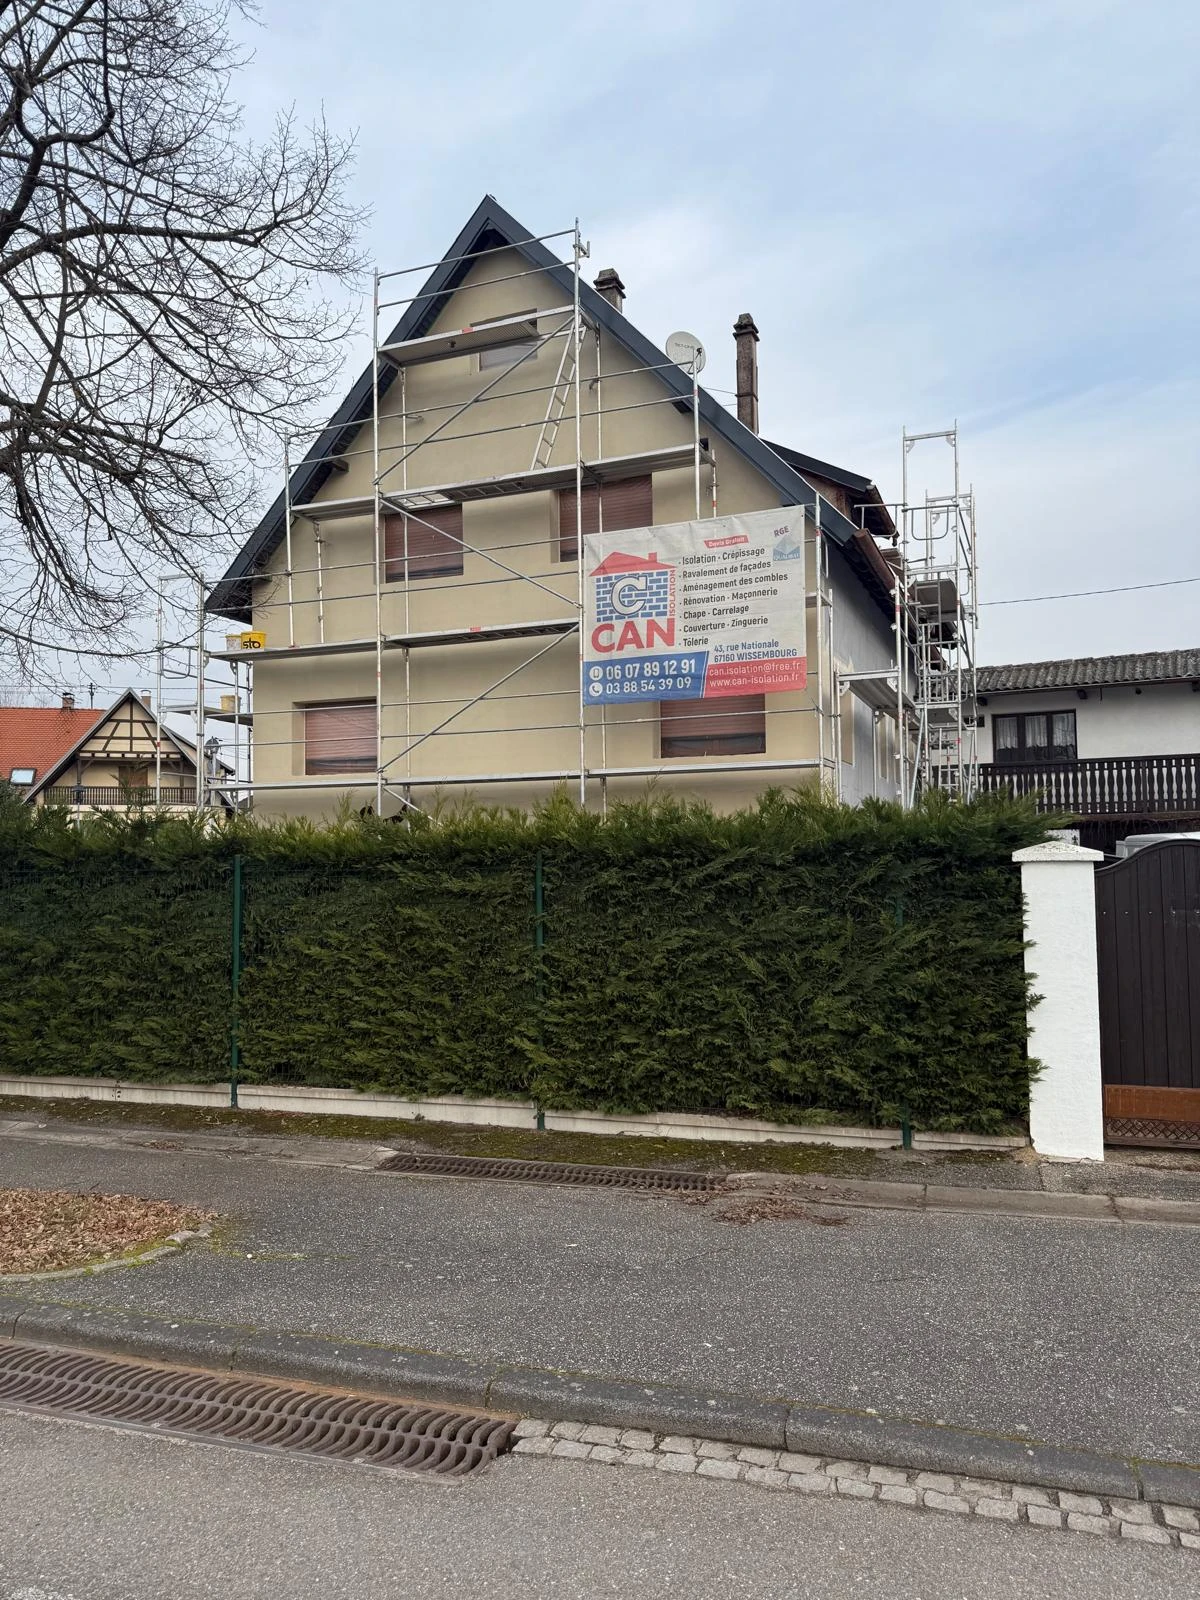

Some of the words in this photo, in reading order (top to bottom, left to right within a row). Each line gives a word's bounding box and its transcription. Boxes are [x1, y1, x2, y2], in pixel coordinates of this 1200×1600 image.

[773, 525, 790, 537] RGE
[682, 554, 716, 565] Isolation
[722, 548, 765, 561] Crépissage
[682, 567, 728, 578] Ravalement
[730, 565, 739, 574] de
[740, 561, 771, 572] façades
[683, 579, 737, 592] Aménagement
[739, 577, 753, 586] des
[754, 572, 788, 583] combles
[683, 594, 726, 606] Rénovation
[731, 587, 778, 600] Maçonnerie
[683, 610, 706, 620] Chape
[712, 604, 750, 616] Carrelage
[683, 622, 725, 633] Couverture
[731, 616, 769, 628] Zinguerie
[242, 637, 261, 649] sto
[591, 618, 675, 653] CAN
[683, 637, 709, 647] Tôlerie
[741, 639, 779, 650] Nationale
[714, 654, 735, 663] 67160
[737, 649, 797, 661] WISSEMBOURG
[606, 665, 622, 680] 06
[625, 663, 640, 678] 07
[643, 661, 660, 676] 89
[663, 660, 677, 675] 12
[681, 658, 696, 674] 91
[709, 661, 800, 676] can.isolation@free.fr
[606, 683, 620, 694] 03
[623, 681, 638, 693] 88
[641, 680, 655, 692] 54
[659, 678, 673, 690] 39
[676, 676, 692, 689] 09
[709, 673, 799, 687] www.can-isolation.fr
